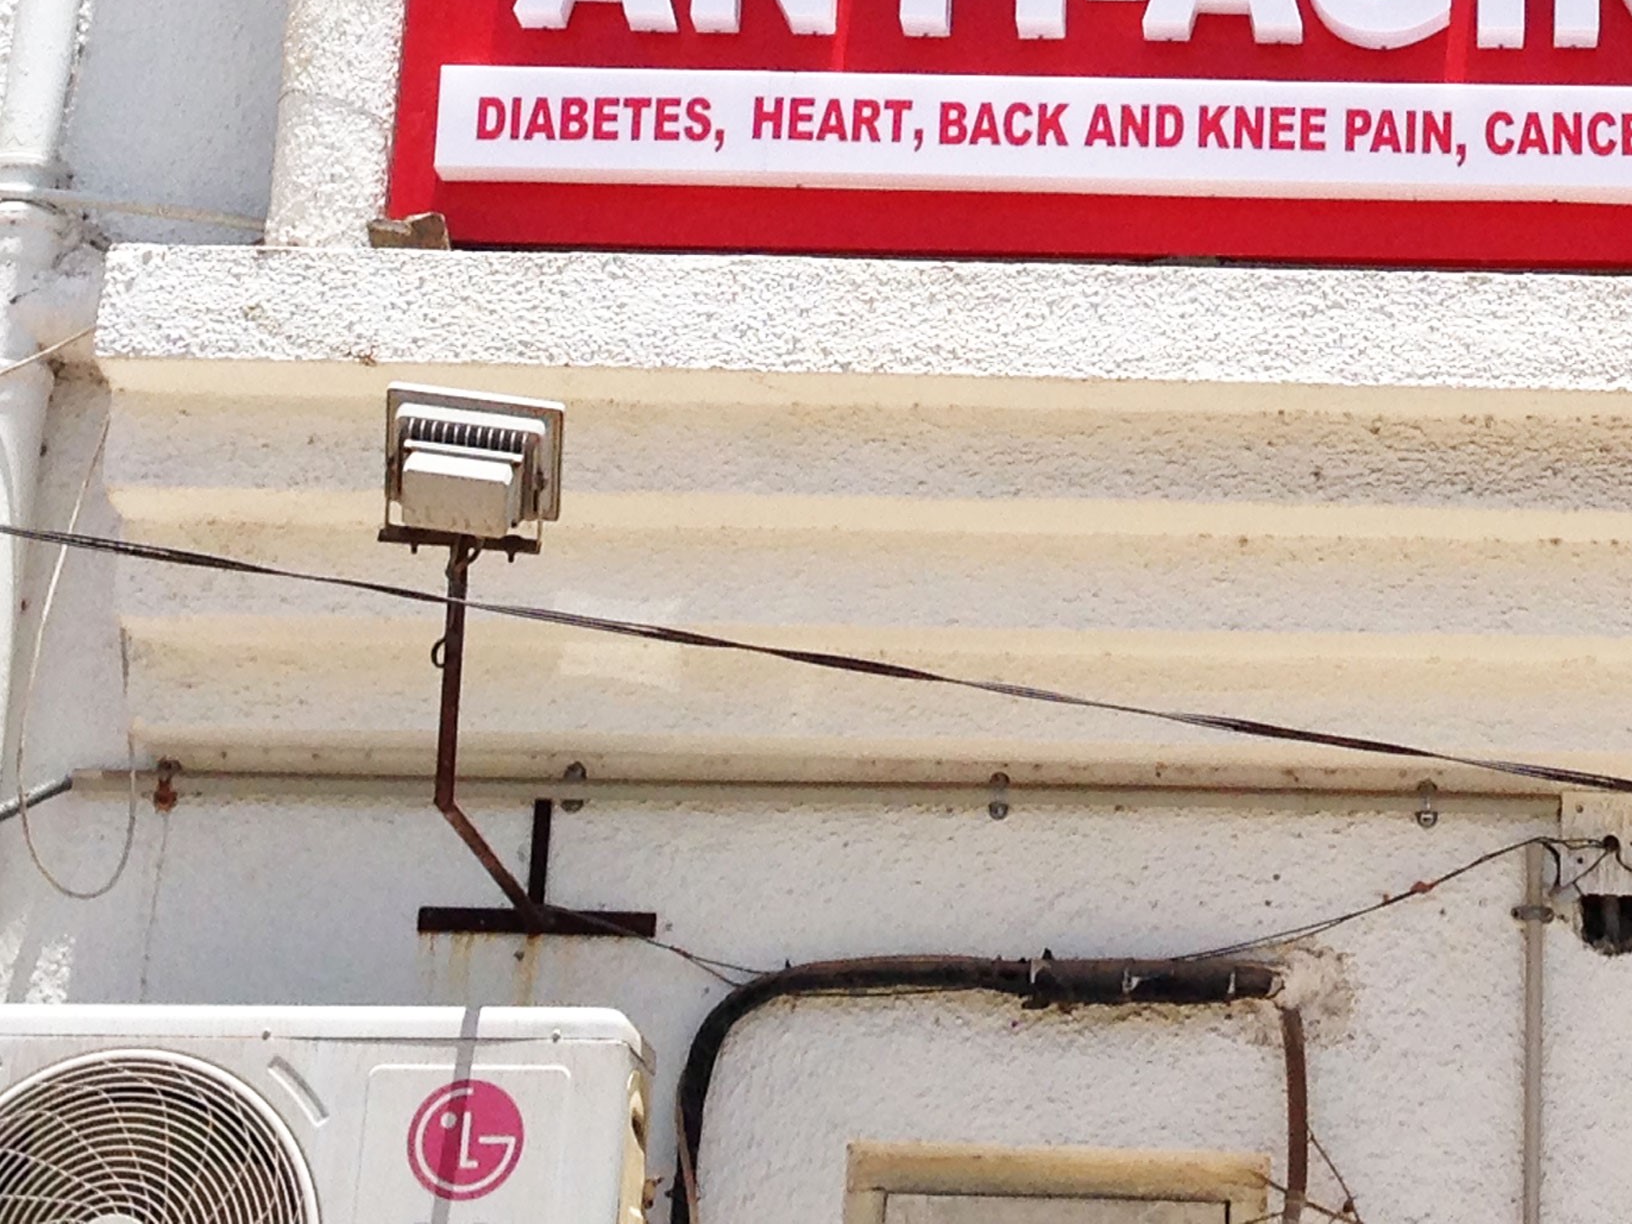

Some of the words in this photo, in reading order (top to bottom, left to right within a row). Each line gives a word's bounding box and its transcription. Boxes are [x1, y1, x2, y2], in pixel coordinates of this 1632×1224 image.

[477, 97, 724, 150] DIABETES,
[753, 97, 923, 149] HEART,
[939, 102, 1067, 146] BACK
[1085, 104, 1184, 147] AND
[1198, 106, 1326, 150] KNEE
[1345, 109, 1466, 165] PAIN,
[414, 1086, 517, 1194] LG
